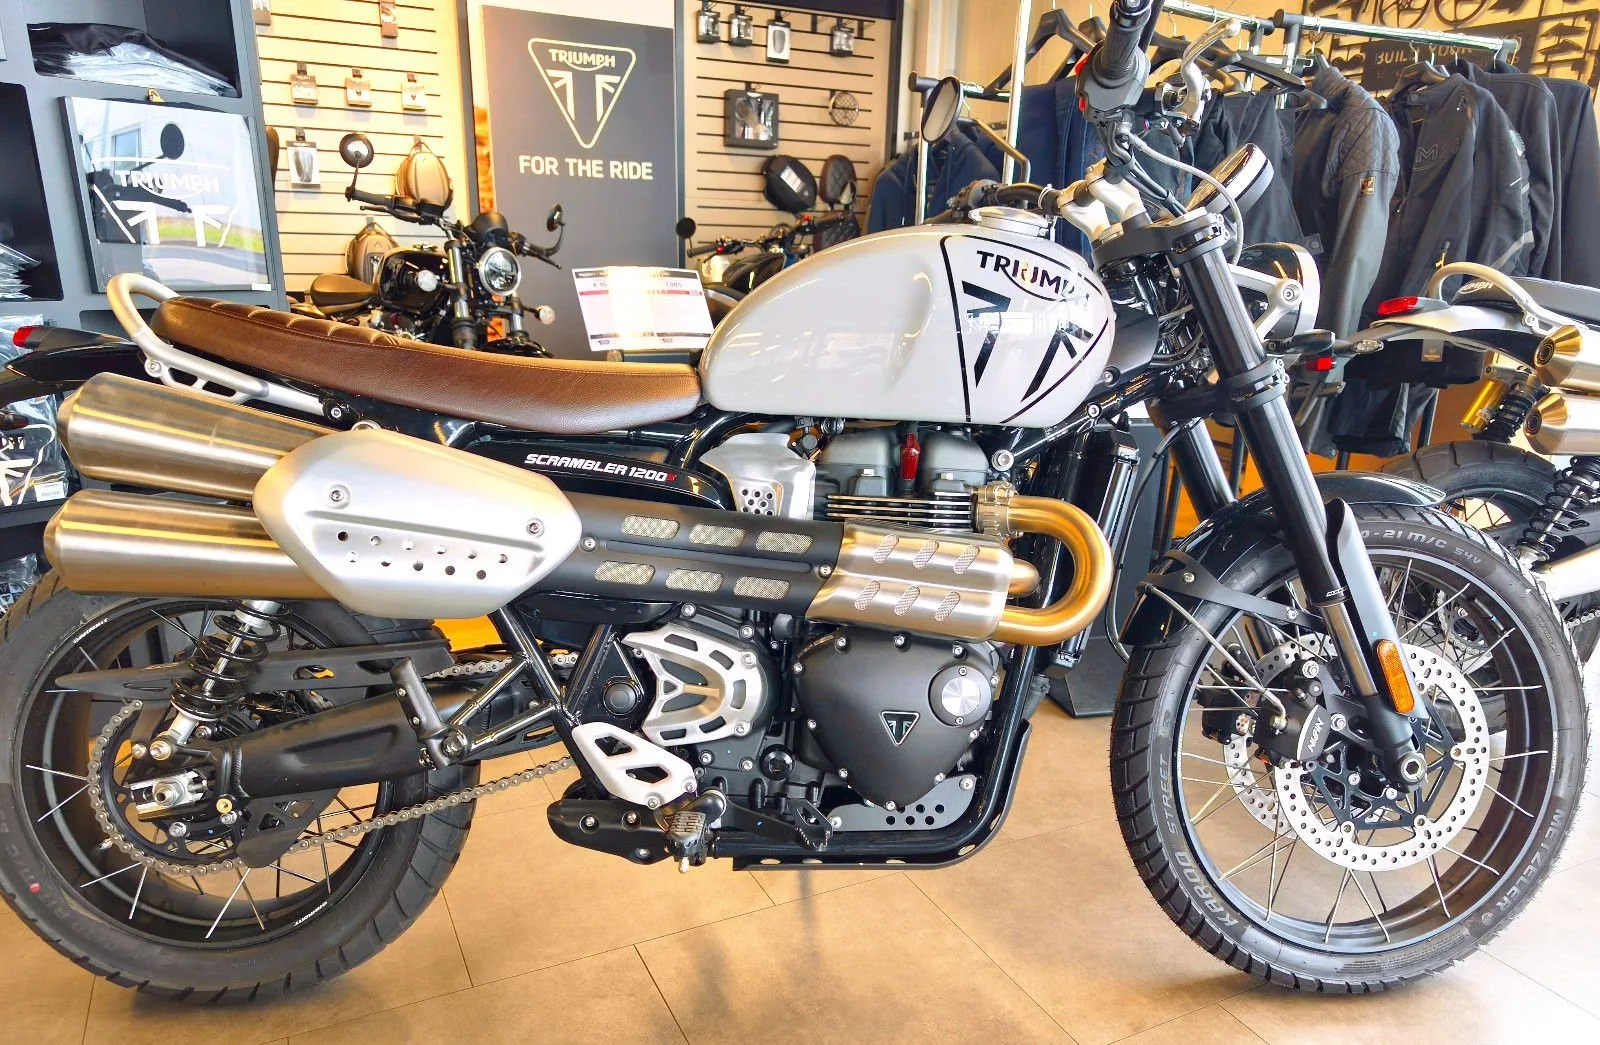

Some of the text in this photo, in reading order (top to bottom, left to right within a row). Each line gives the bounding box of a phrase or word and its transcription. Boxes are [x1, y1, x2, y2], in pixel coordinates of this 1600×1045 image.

[548, 48, 616, 69] TRIUMPH
[518, 154, 654, 180] FOR THE RIDE
[115, 170, 220, 194] TRIUMPH
[524, 453, 628, 476] SCRAMBLER
[1406, 531, 1448, 549] M/C
[1452, 546, 1482, 565] 54V
[1159, 753, 1239, 928] KAROO STREET
[1498, 808, 1567, 912] METZELER
